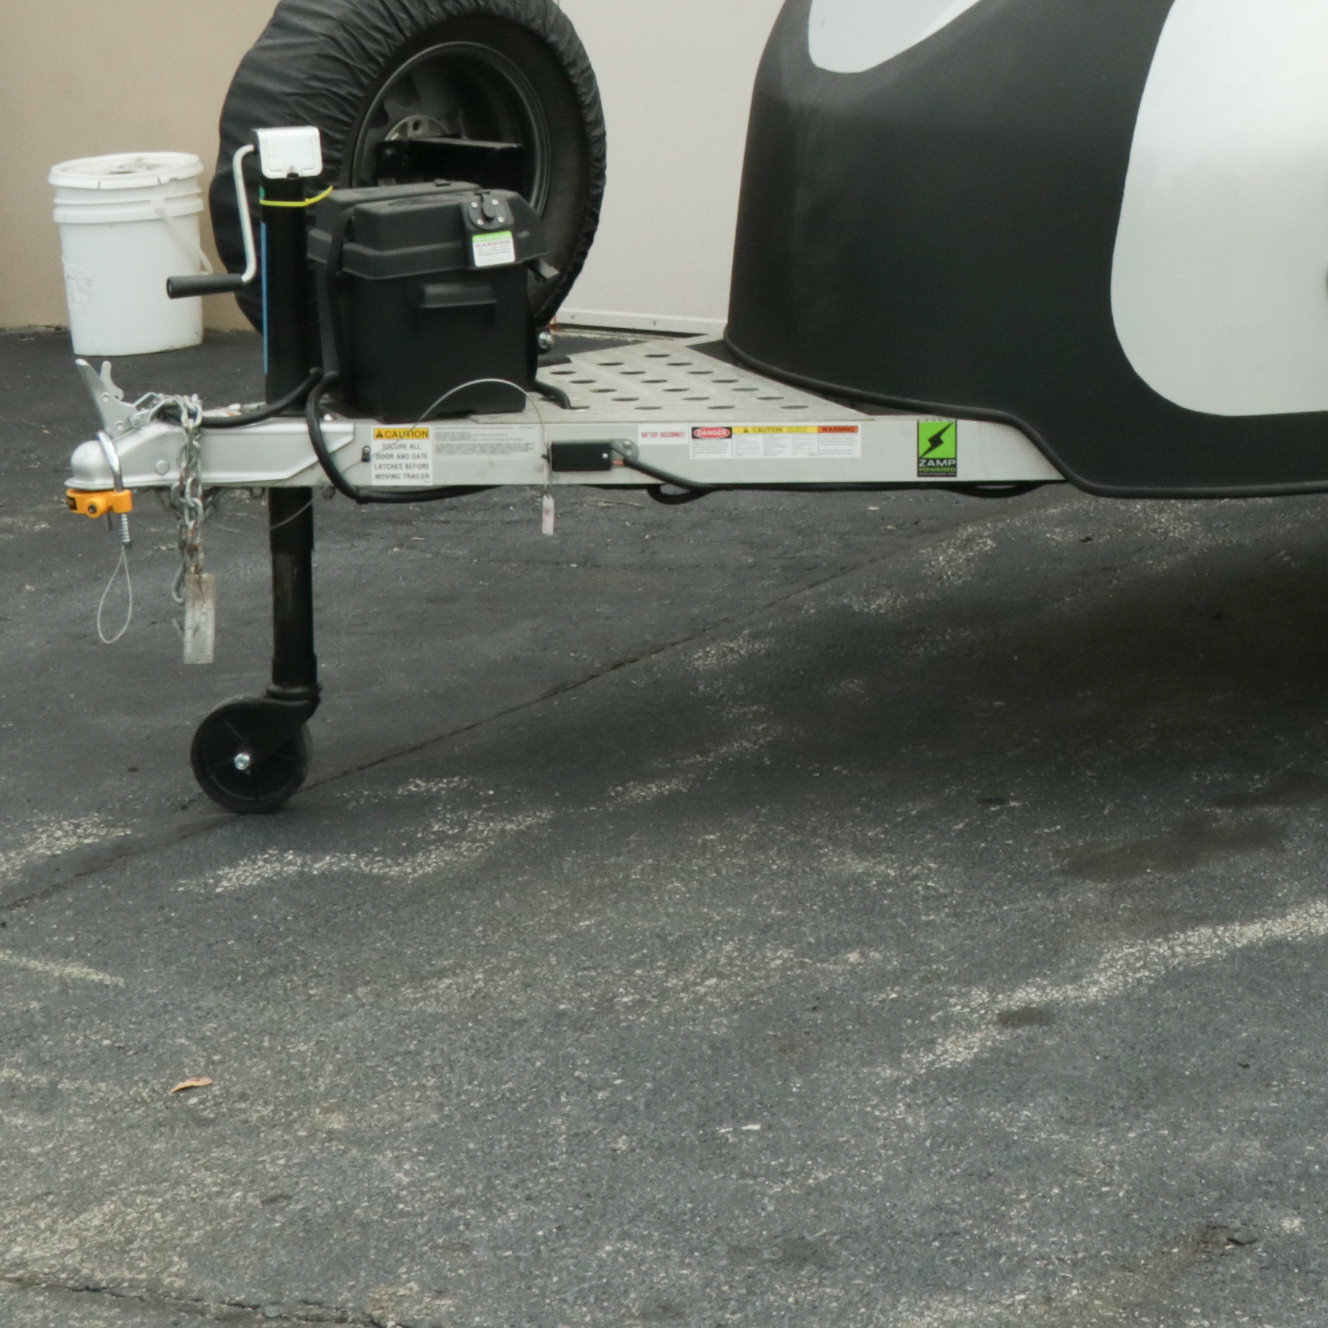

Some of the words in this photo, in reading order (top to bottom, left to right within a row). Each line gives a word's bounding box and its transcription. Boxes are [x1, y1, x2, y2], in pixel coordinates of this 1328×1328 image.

[384, 430, 429, 439] CAUTION
[696, 429, 728, 437] DANGER
[382, 442, 408, 450] SECURE
[409, 442, 422, 450] ALL
[375, 452, 395, 461] DOOR
[396, 452, 410, 460] AND
[411, 452, 428, 460] GATE
[405, 462, 430, 470] BEFORE
[919, 459, 956, 467] ZAMP
[403, 472, 430, 480] TRAILER
